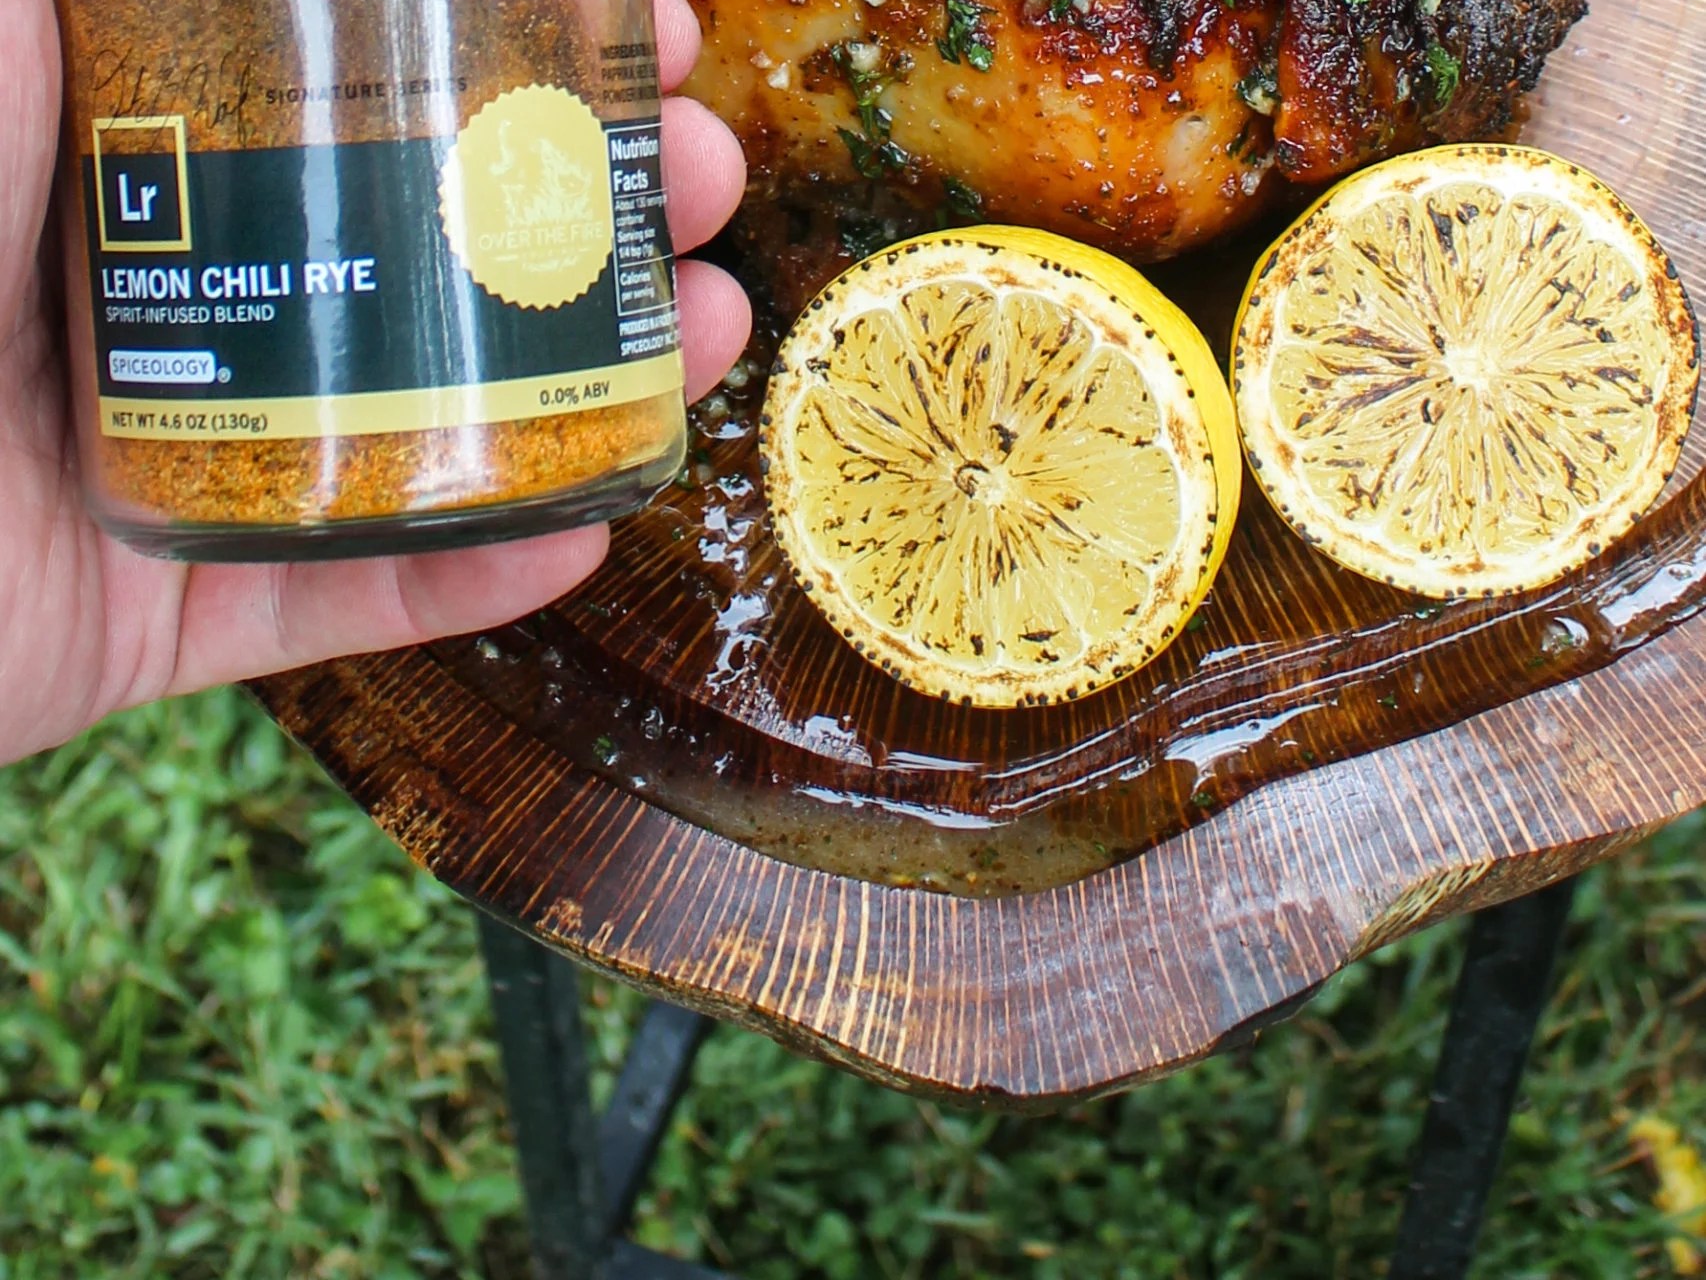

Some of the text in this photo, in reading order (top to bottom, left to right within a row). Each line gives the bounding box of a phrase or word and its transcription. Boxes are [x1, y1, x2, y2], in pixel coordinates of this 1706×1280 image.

[266, 82, 385, 104] SIGNATURE
[610, 136, 659, 161] Nutrition
[613, 169, 649, 193] Facts
[118, 173, 157, 221] Lr
[478, 221, 604, 250] OVER THE FIRE
[617, 230, 643, 243] Serving
[102, 258, 377, 300] LEMON CHILI RYE
[105, 304, 275, 324] SPIRIT-INFUSED BLEND
[540, 380, 610, 406] 0.0% ABV
[112, 412, 268, 432] NET WT 4.6 OZ (130g)
